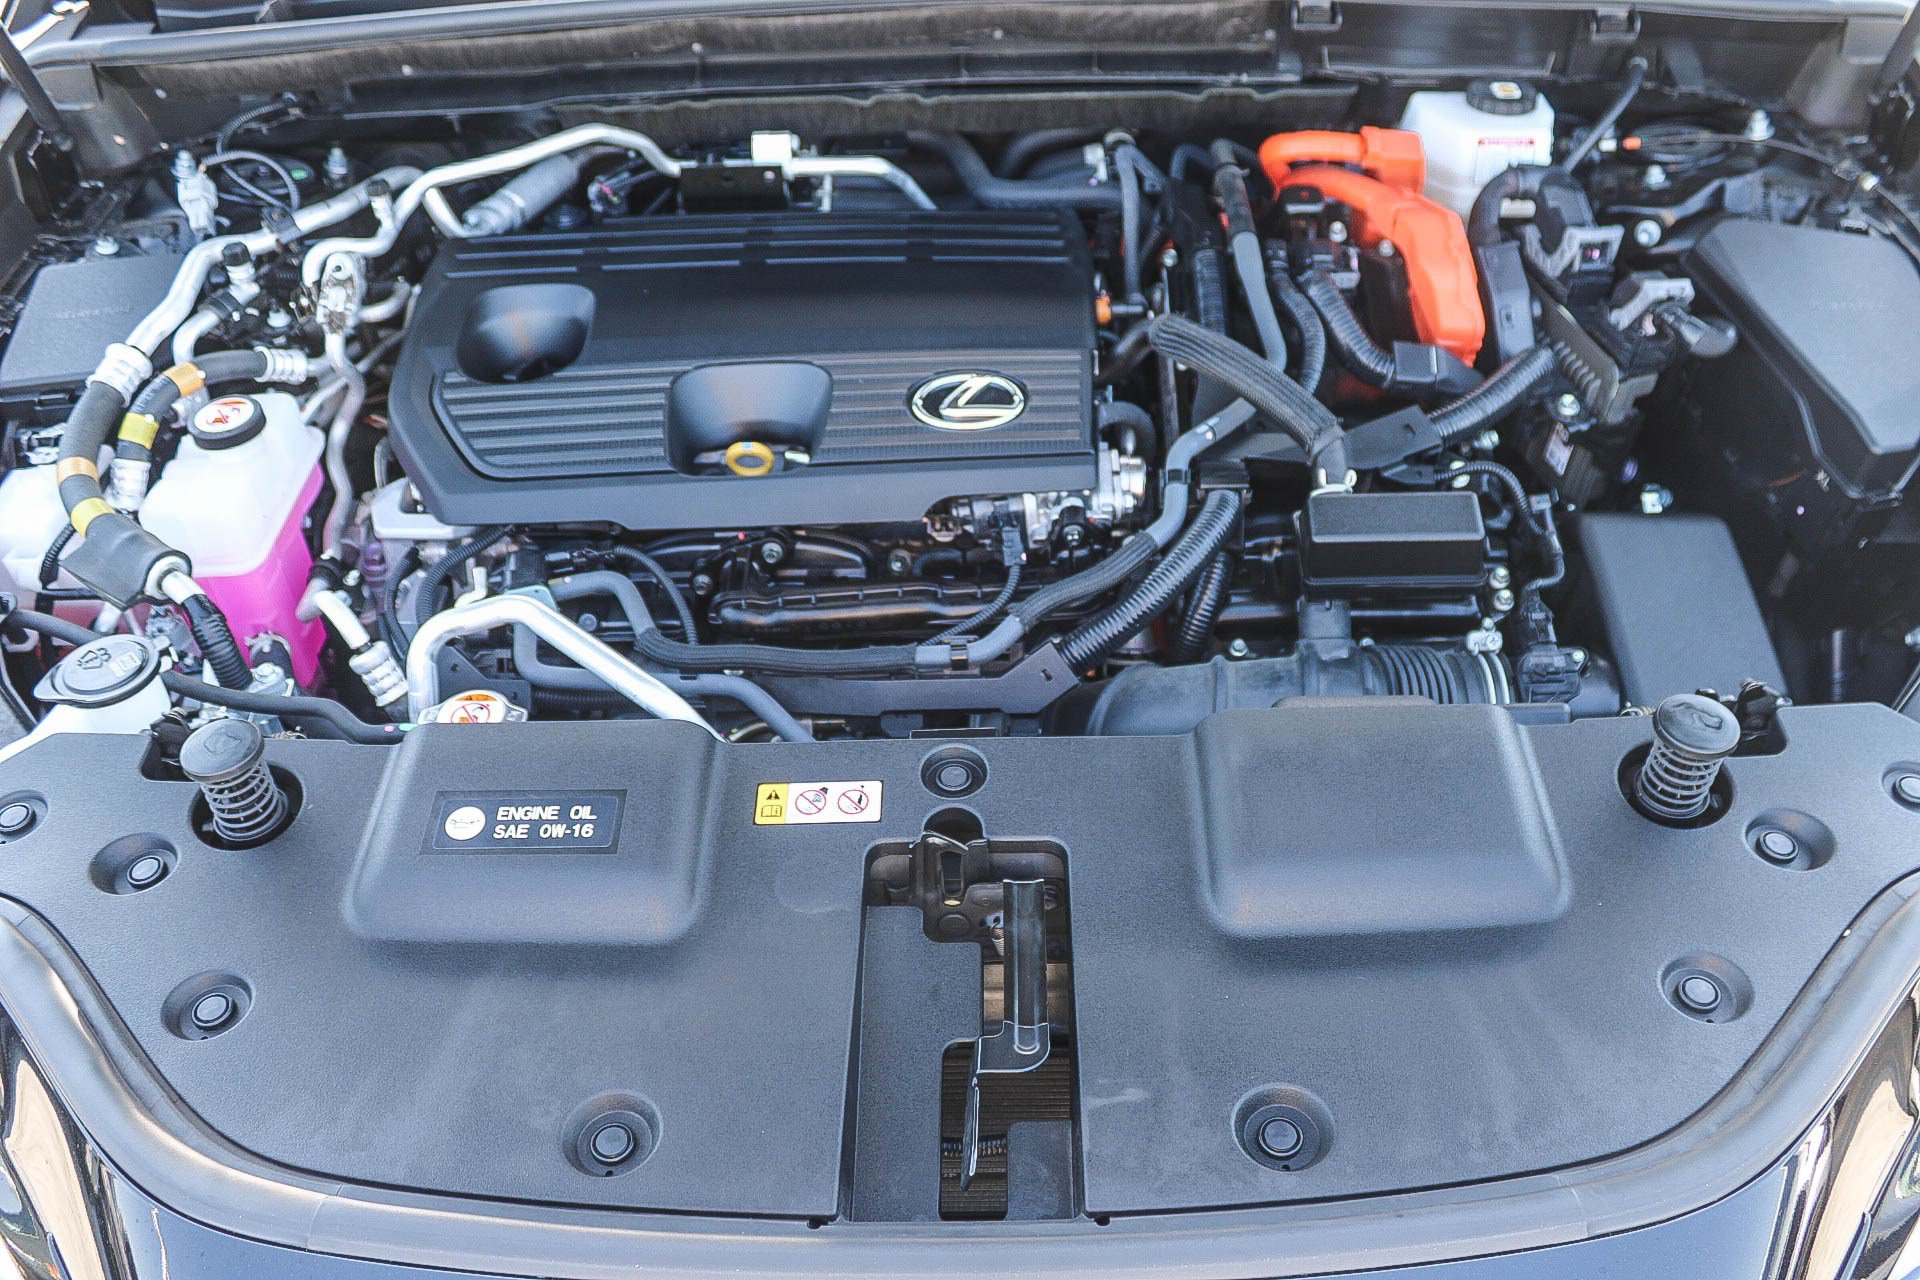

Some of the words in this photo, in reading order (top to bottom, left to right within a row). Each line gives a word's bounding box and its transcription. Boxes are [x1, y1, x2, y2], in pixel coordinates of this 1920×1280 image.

[496, 805, 560, 821] ENGINE
[569, 805, 598, 820] OIL
[493, 824, 529, 838] SAE
[539, 823, 594, 838] 0W-16
